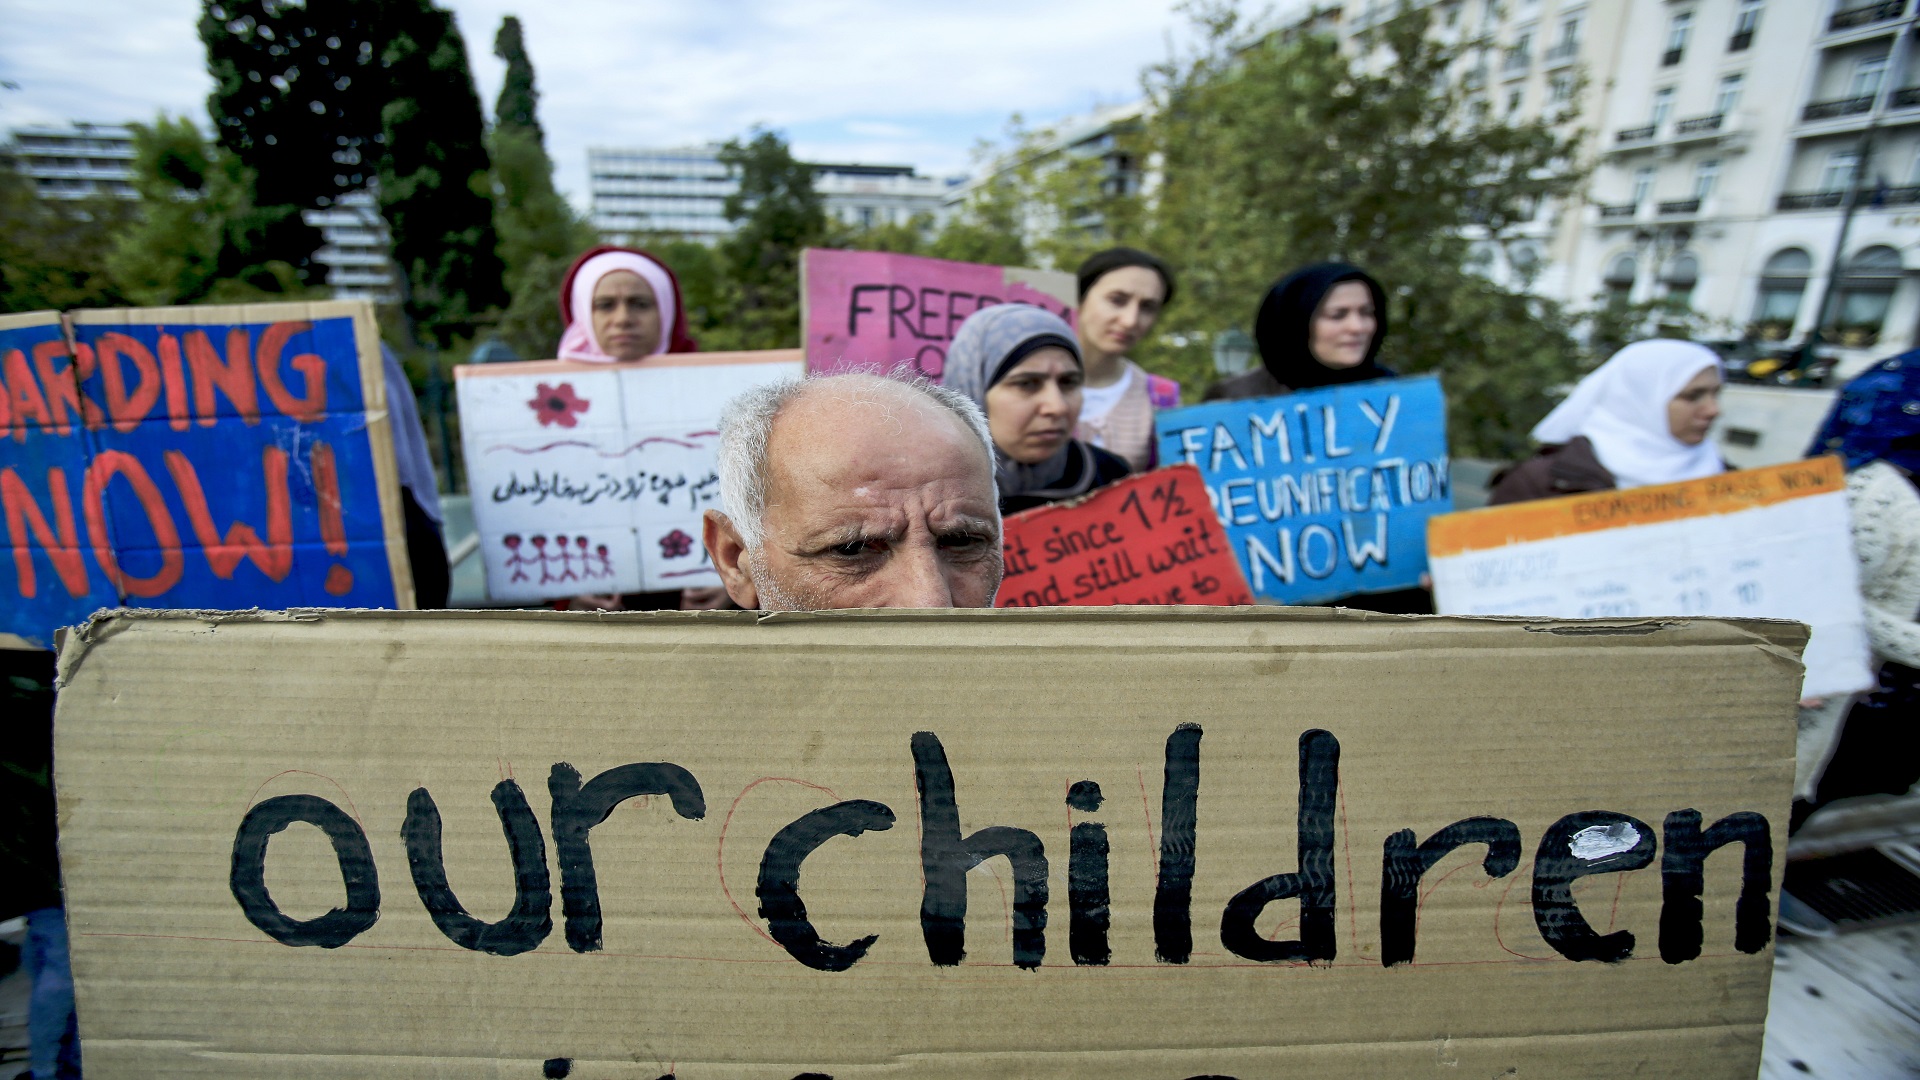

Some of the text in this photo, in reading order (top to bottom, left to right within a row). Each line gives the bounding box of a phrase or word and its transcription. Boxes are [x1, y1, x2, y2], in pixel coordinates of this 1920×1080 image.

[848, 283, 1072, 341] FREE
[0, 322, 327, 444] ARDING
[1165, 394, 1400, 473] FAMILY
[0, 443, 354, 599] NOW!
[1043, 520, 1124, 564] since
[1073, 548, 1143, 599] still
[1148, 518, 1219, 574] wait
[1245, 512, 1389, 591] NOW
[1191, 570, 1221, 596] to
[228, 721, 1773, 973] our children
